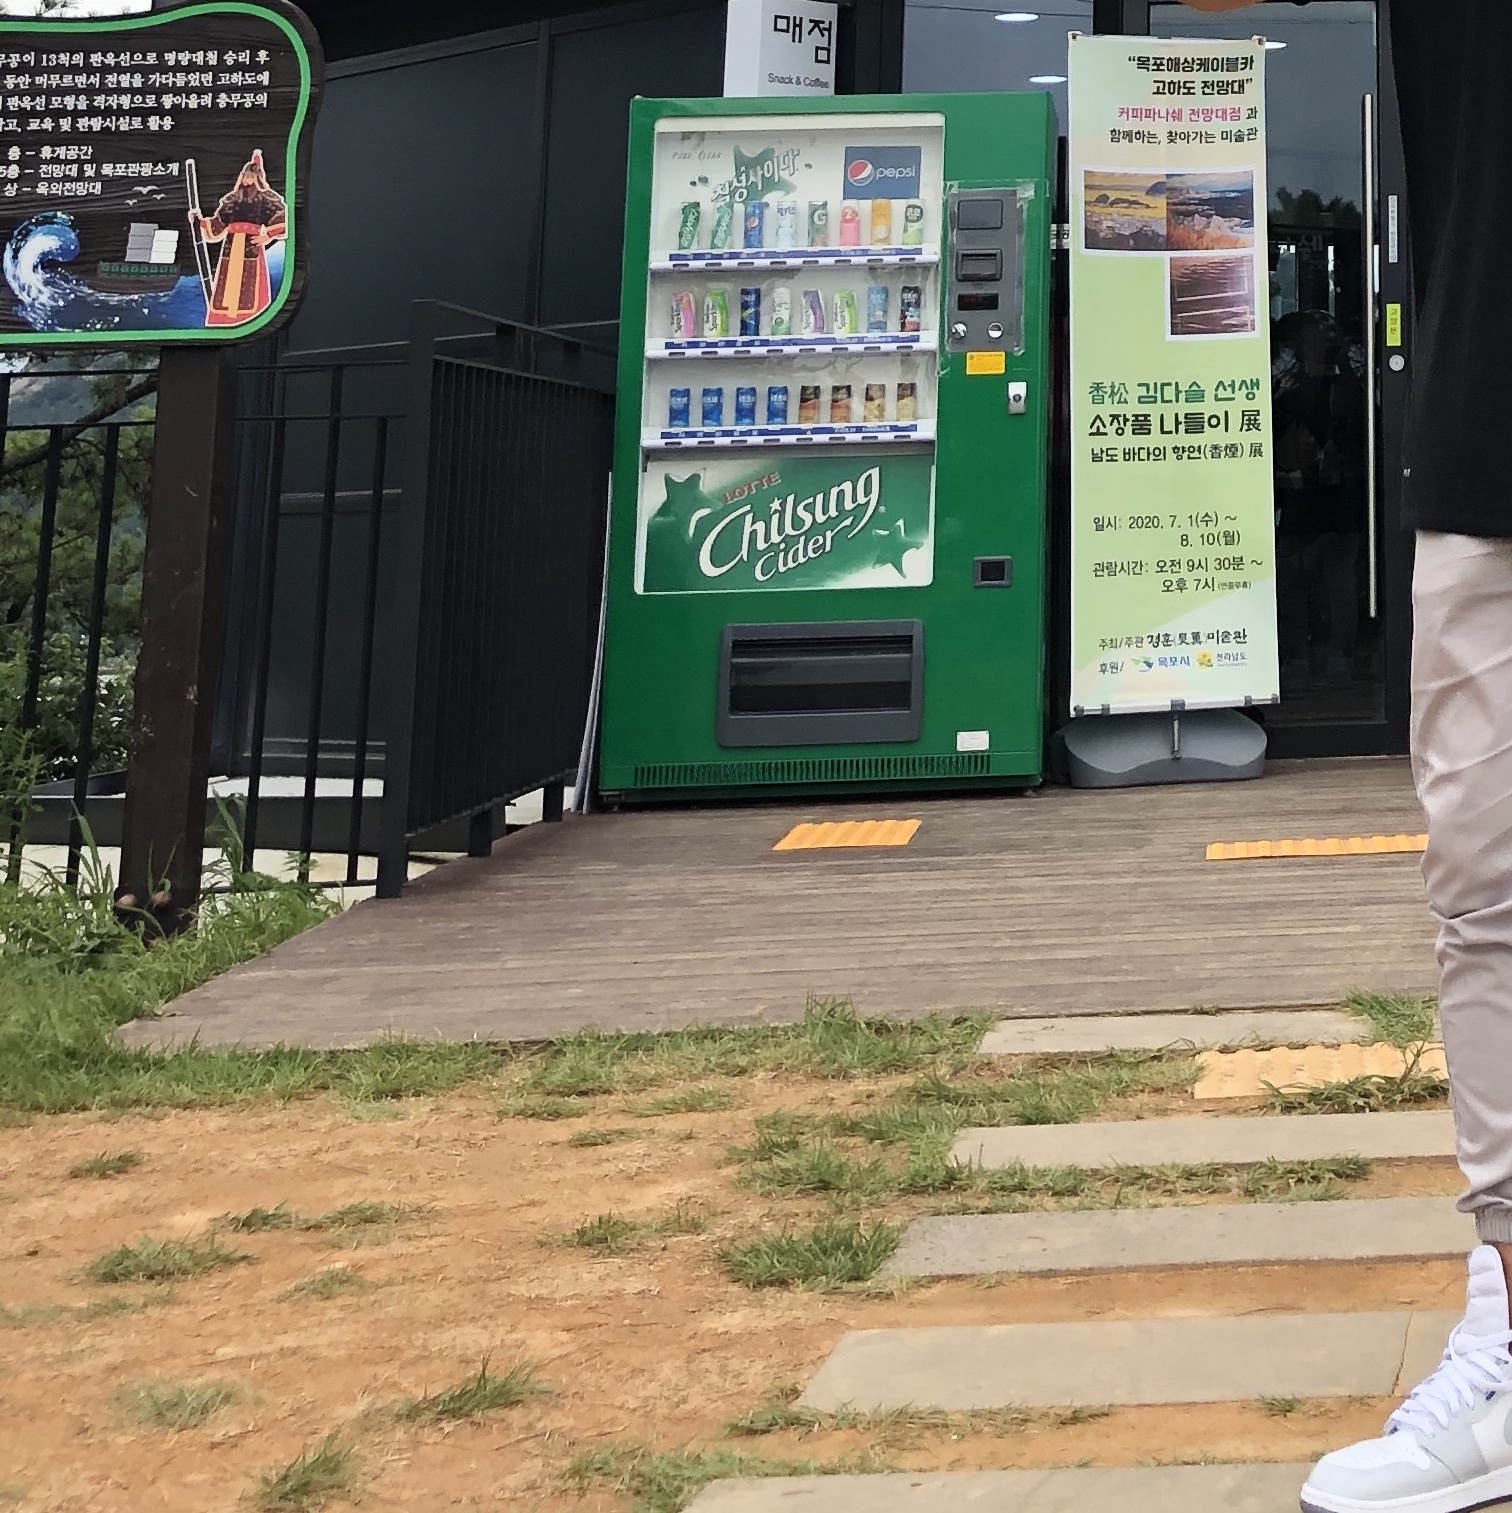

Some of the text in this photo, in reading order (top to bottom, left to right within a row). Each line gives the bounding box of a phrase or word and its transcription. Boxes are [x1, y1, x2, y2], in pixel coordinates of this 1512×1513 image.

[773, 14, 832, 65] 매점
[223, 50, 250, 65] 승리
[255, 50, 269, 65] 후
[4, 73, 32, 89] 동안
[35, 73, 100, 88] 머무르면서
[217, 71, 270, 86] 고하도에
[768, 72, 830, 89] Snack & Coffee
[1152, 80, 1196, 95] 고하도
[6, 95, 46, 111] 판옥선
[1189, 107, 1241, 122] 전망대점
[1246, 106, 1258, 121] 과
[1110, 127, 1258, 145] 함께하는, 찾아가는 미술관
[39, 145, 93, 160] 휴게공간
[39, 164, 78, 177] 전망대
[84, 163, 96, 177] 및
[101, 162, 179, 177] 목포관광소개
[876, 165, 916, 180] pepsi
[4, 183, 18, 196] 상
[36, 182, 102, 195] 옥외전망대
[1088, 378, 1260, 405] 香松 김다슬 선생
[1088, 409, 1262, 437] 소장품 나들이 展
[1091, 447, 1119, 462] 남도
[1123, 446, 1166, 461] 바다의
[1249, 443, 1263, 458] 展
[723, 471, 782, 504] LOTTE
[699, 466, 881, 577] Chilsung
[1093, 516, 1122, 531] 일시:
[1128, 516, 1164, 529] 2020.
[1169, 515, 1181, 528] 7.
[1188, 511, 1219, 527] 1(수)
[1180, 530, 1241, 547] 8. 10(월)
[1092, 560, 1149, 578] 관람시간:
[1155, 559, 1182, 574] 오전
[1186, 557, 1208, 572] 9시
[1214, 556, 1245, 571] 30분
[1161, 578, 1188, 593] 오후
[1194, 577, 1215, 591] 7시
[1158, 656, 1190, 668] 목포시
